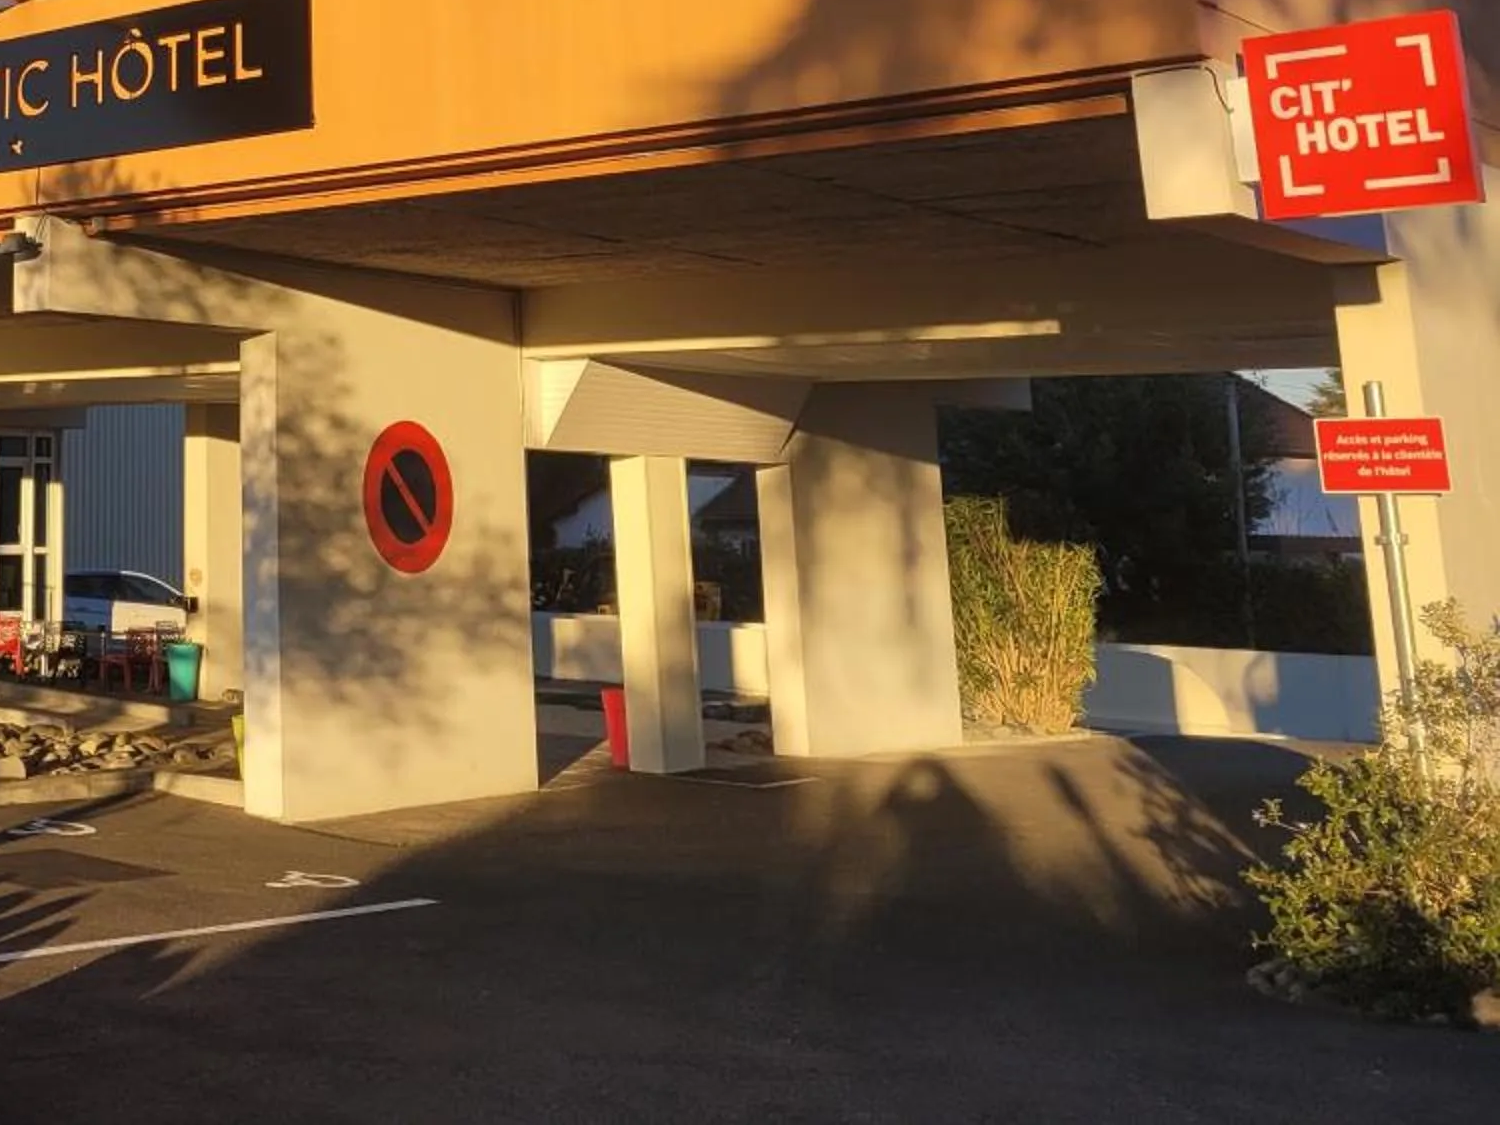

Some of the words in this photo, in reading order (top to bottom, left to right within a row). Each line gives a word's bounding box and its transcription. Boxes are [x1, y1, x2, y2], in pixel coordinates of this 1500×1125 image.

[68, 21, 264, 109] HÔTEL
[1269, 78, 1353, 119] CIT'
[1295, 108, 1445, 155] HOTEL
[1370, 435, 1381, 444] et
[1383, 433, 1429, 447] parking
[1381, 449, 1392, 460] la
[1357, 465, 1372, 476] de
